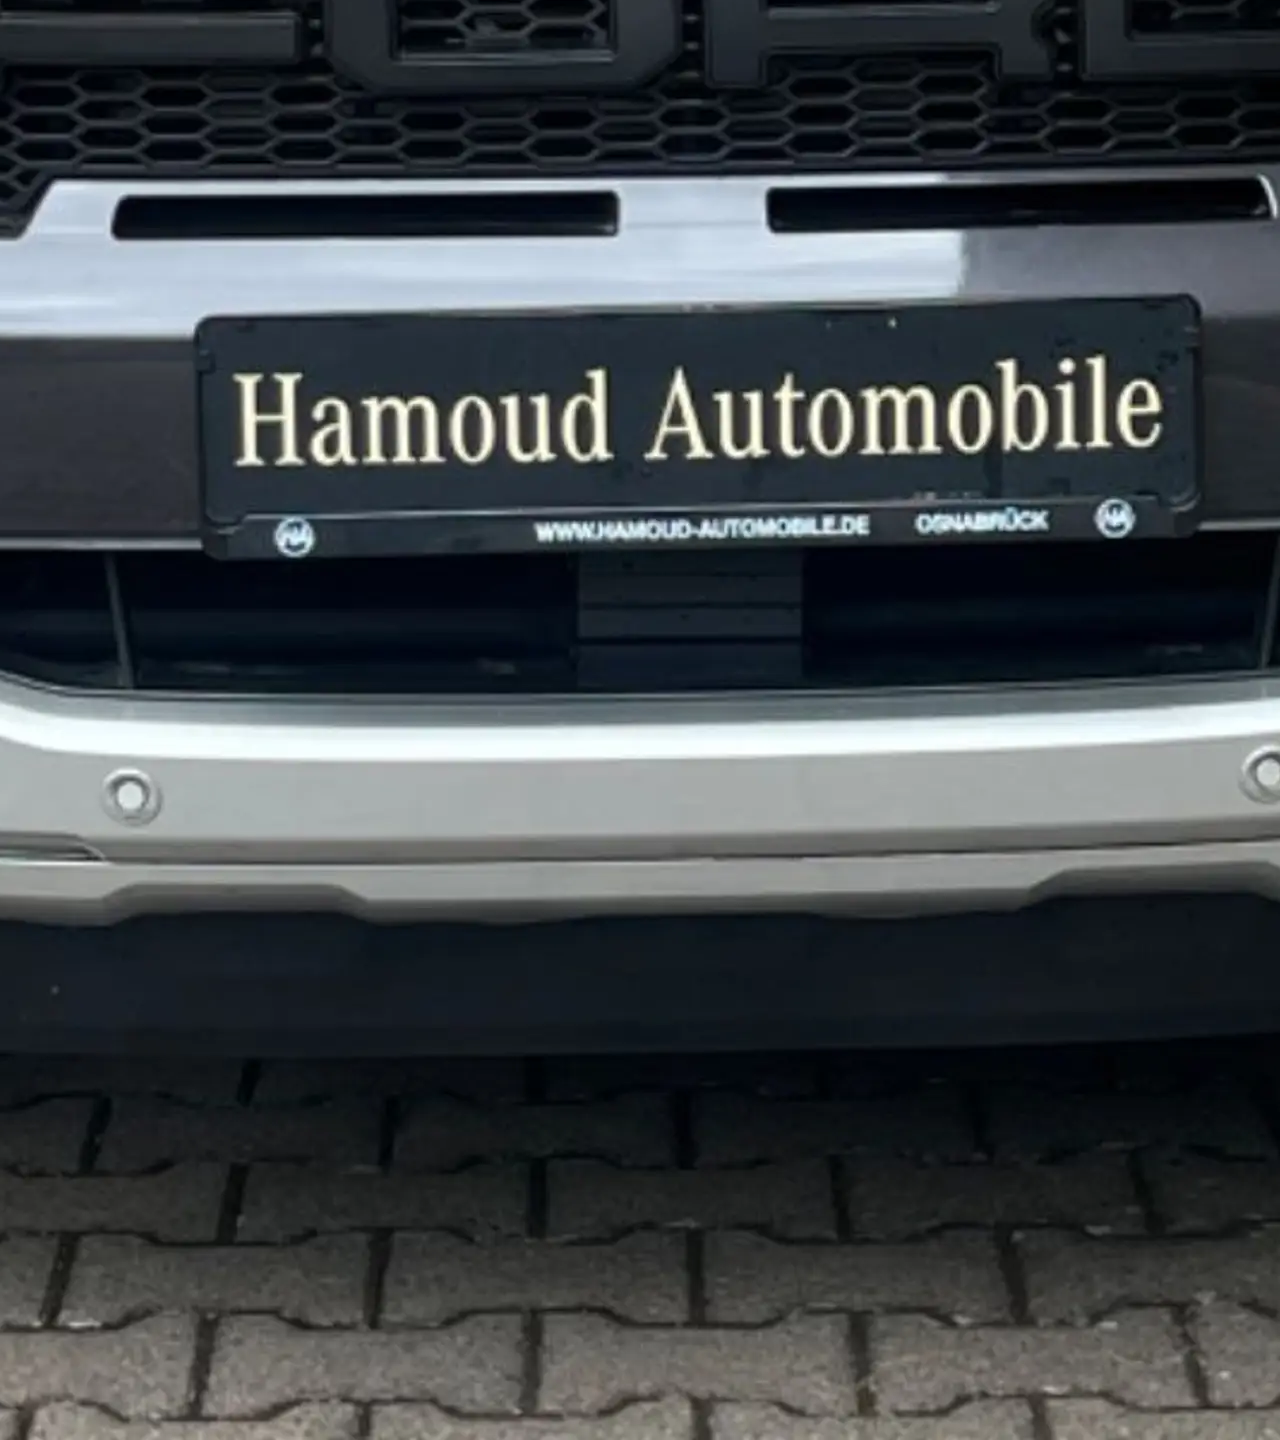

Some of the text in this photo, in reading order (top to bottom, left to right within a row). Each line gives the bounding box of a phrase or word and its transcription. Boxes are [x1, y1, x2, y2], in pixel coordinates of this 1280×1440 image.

[233, 355, 1163, 467] Hamoud Automobile
[534, 506, 1049, 542] WWW.HAMOUD-AUTOMOBILE.DE OSNABRÜCK
